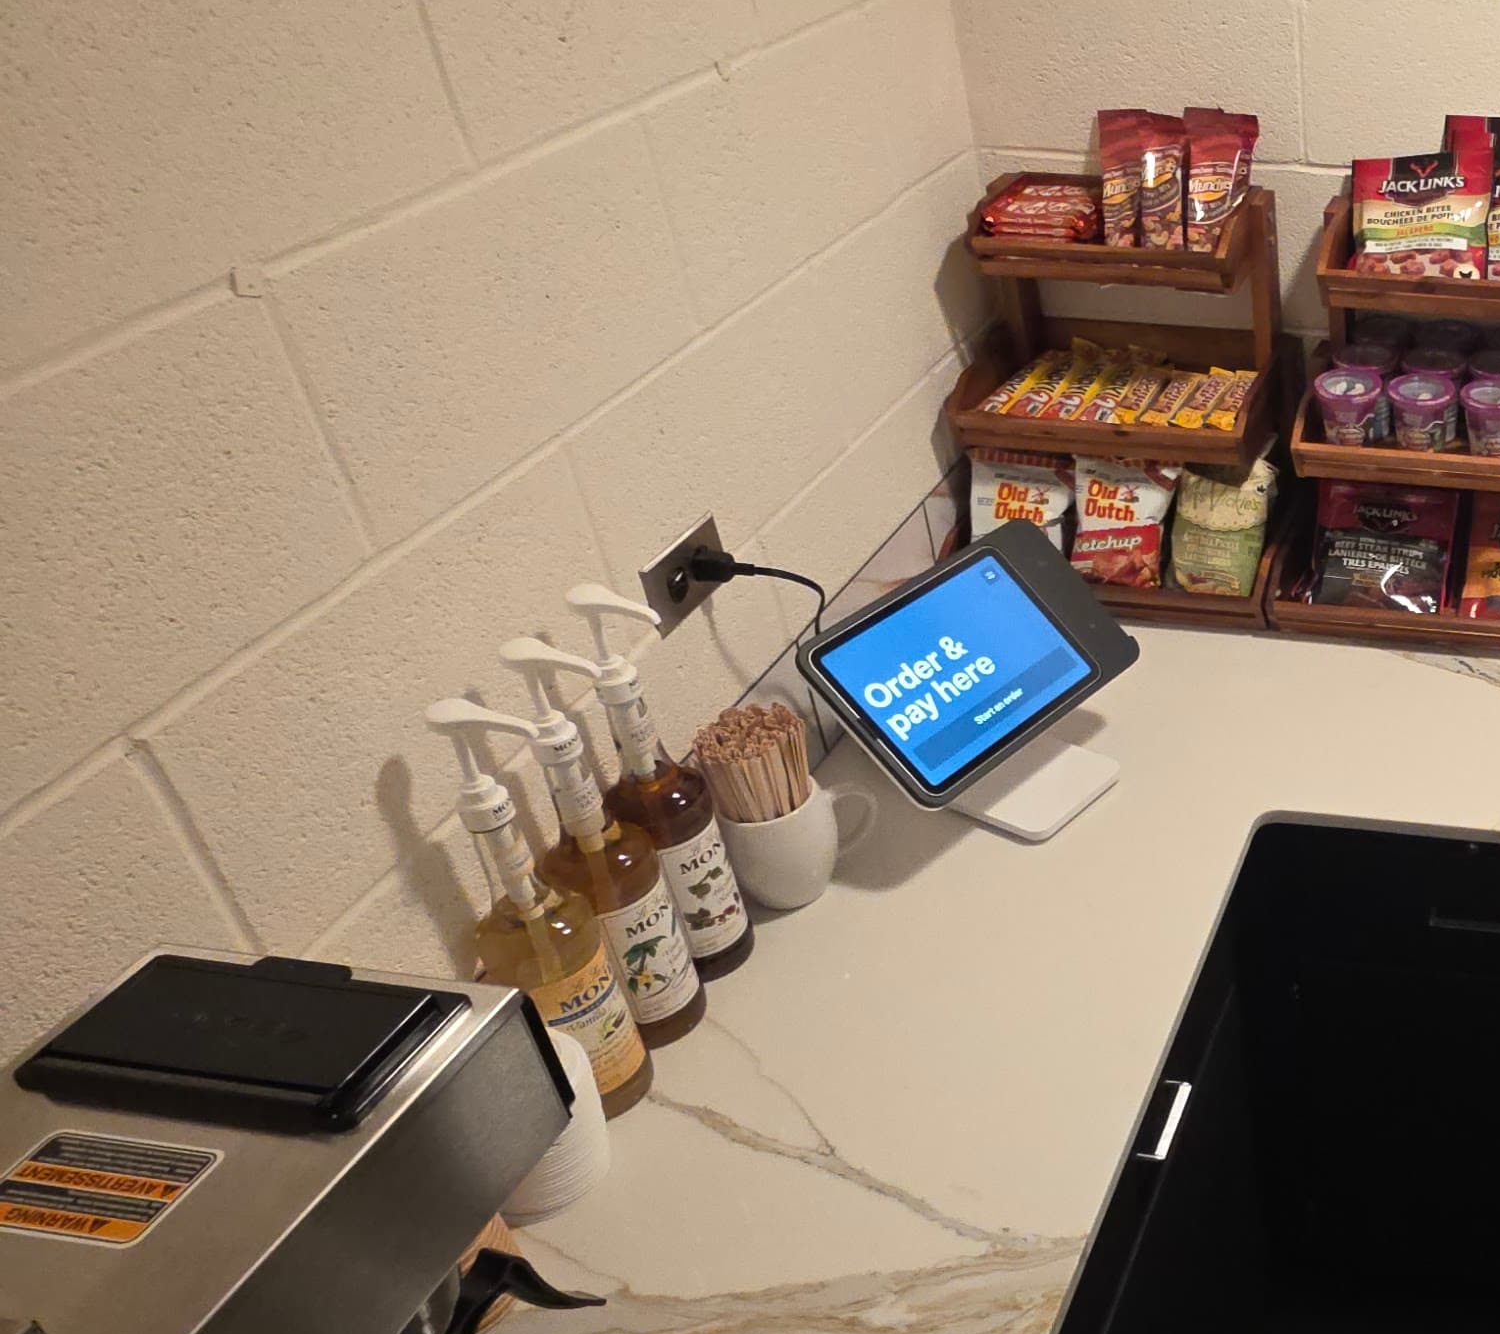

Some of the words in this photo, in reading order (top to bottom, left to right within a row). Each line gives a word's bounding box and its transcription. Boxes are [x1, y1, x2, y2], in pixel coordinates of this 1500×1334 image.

[1378, 180, 1418, 194] JACK
[1384, 208, 1423, 218] CHICKEN
[1425, 205, 1451, 214] BITES
[1416, 214, 1427, 222] DE
[997, 482, 1028, 501] Old
[1087, 478, 1119, 500] Old
[994, 500, 1044, 524] Dutch
[1084, 497, 1135, 522] Dutch
[1073, 535, 1143, 554] Ketchup
[864, 651, 943, 708] Order
[938, 635, 969, 661] &
[886, 692, 940, 742] pay
[930, 656, 997, 704] here
[974, 708, 995, 724] Start
[994, 701, 1005, 712] an
[1003, 688, 1023, 704] order
[19, 1163, 157, 1195] AVERTISSEMENT
[6, 1207, 89, 1234] WARNING
